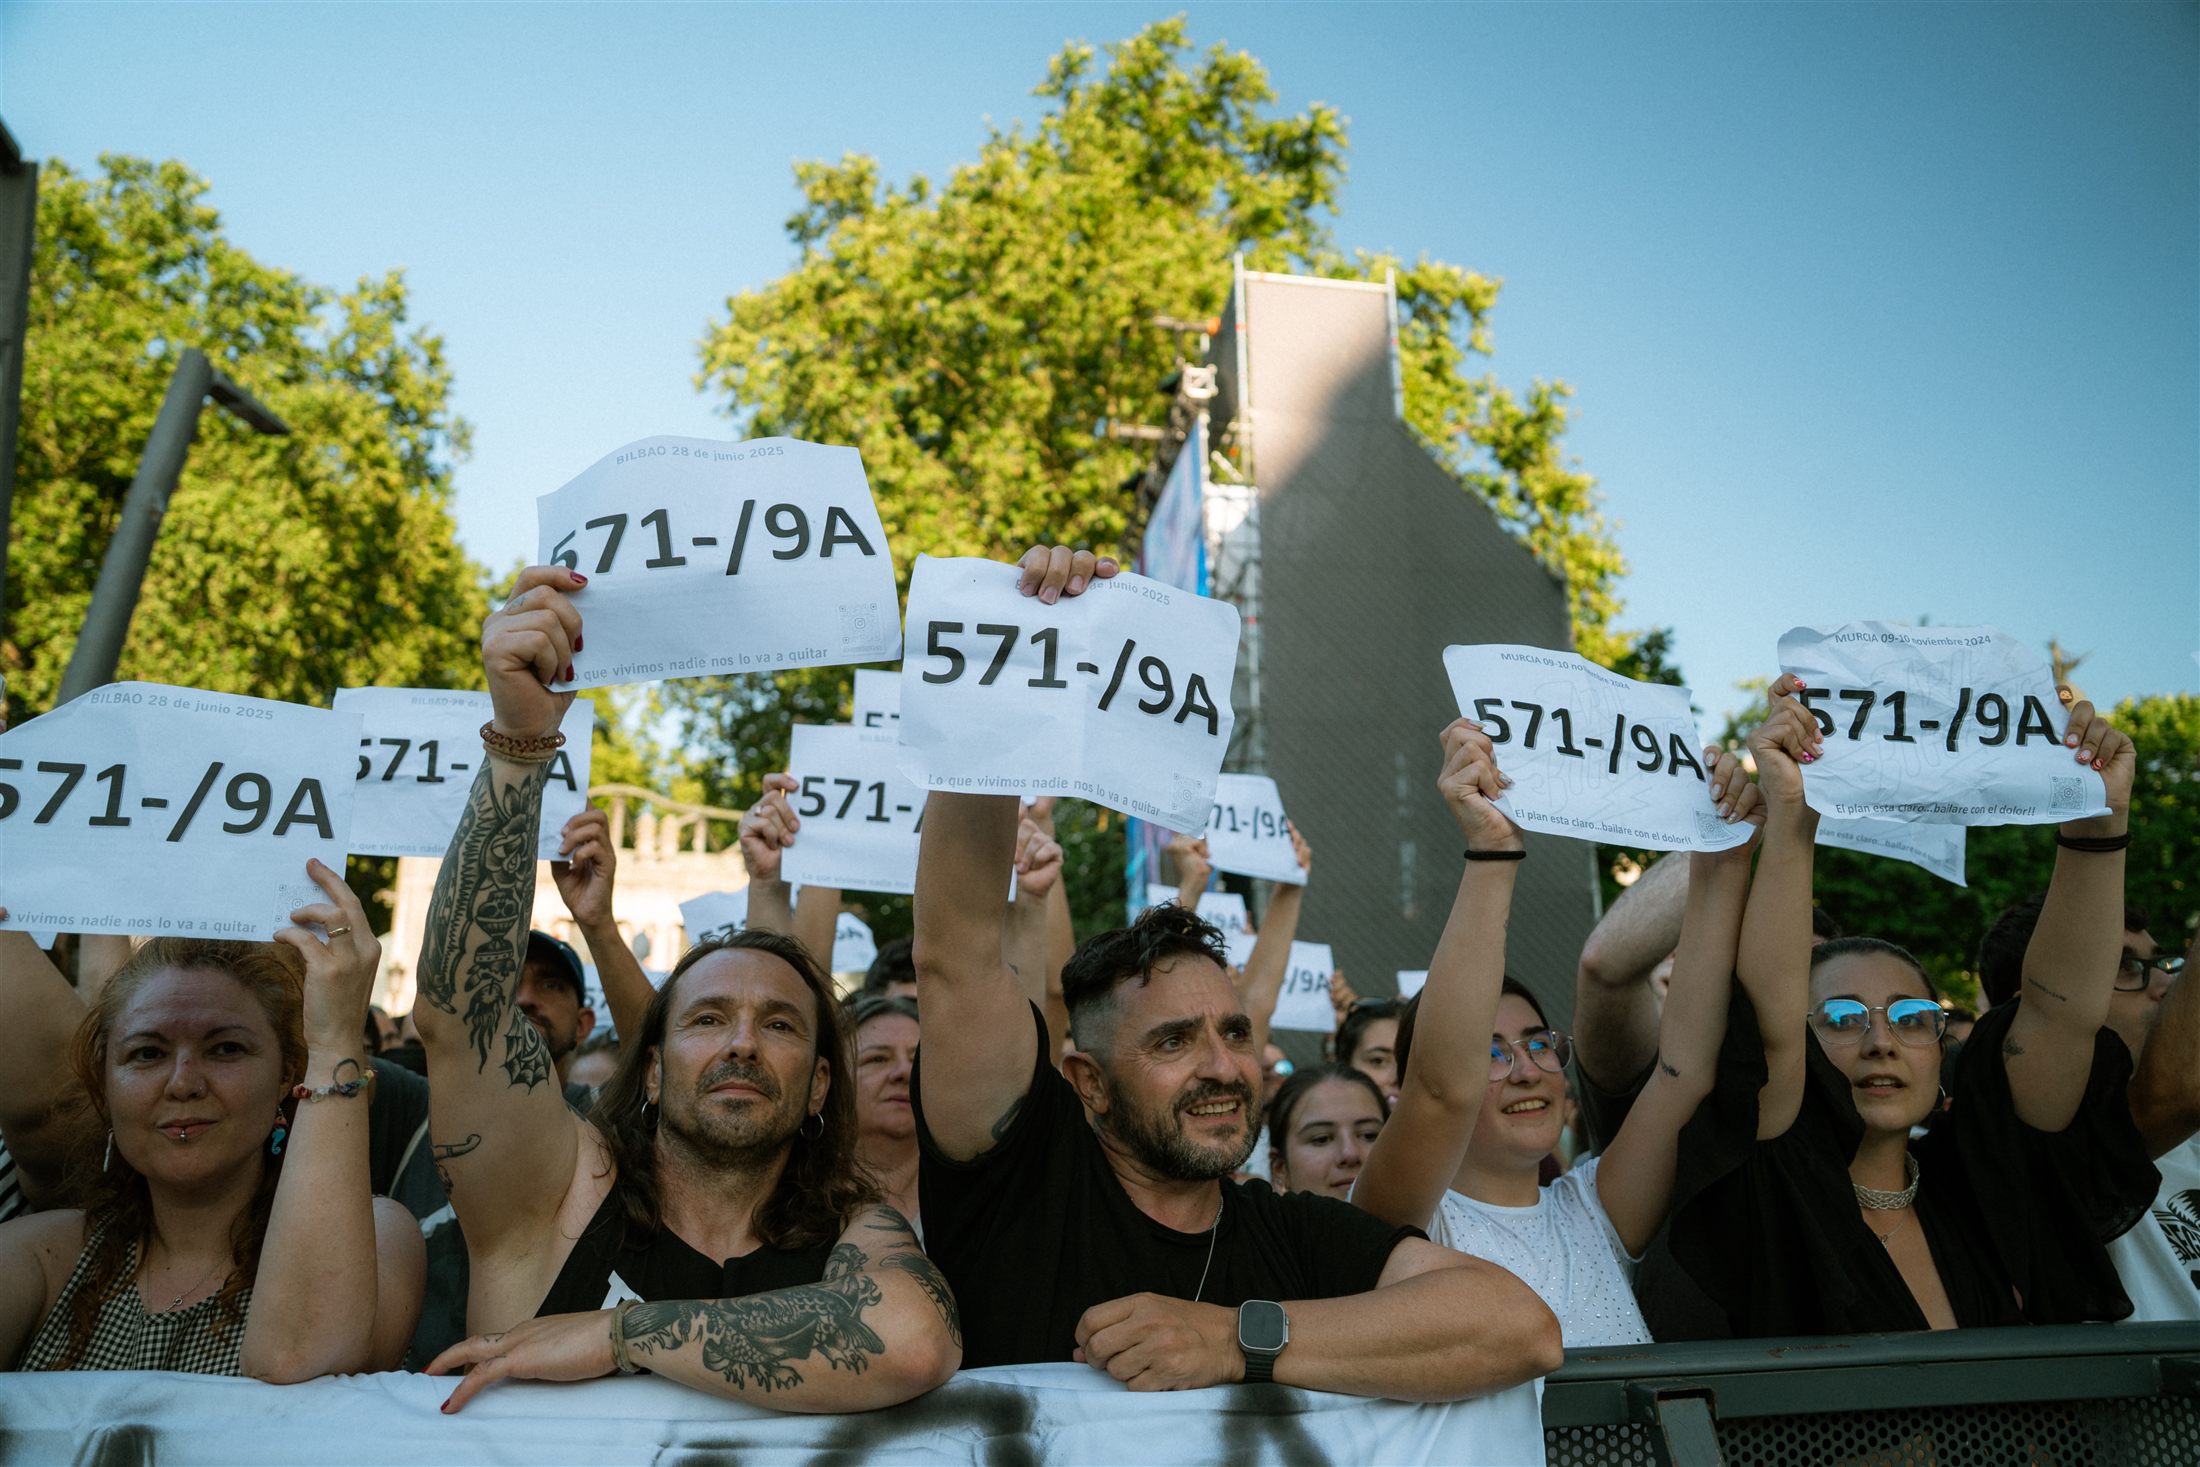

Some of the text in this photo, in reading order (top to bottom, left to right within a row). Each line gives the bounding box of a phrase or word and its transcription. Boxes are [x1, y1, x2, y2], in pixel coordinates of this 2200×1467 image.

[616, 446, 784, 464] BILBAO 28 de junio 2025
[1109, 579, 1138, 593] junio
[1142, 586, 1170, 606] 2025
[1835, 632, 1991, 647] MURCIA 09-10 noviembre 2024
[584, 669, 608, 684] que
[612, 661, 664, 677] vivimos
[669, 655, 706, 672] nadie
[711, 656, 734, 667] nos
[739, 652, 751, 665] lo
[756, 653, 771, 663] va
[776, 653, 784, 662] a
[788, 648, 828, 661] quitar
[1500, 653, 1541, 664] MURCIA
[1543, 659, 1569, 669] 09-10
[922, 620, 1218, 736] 571-/9A
[90, 692, 273, 720] BILBAO 28 de junio 2025
[1800, 687, 2064, 752] 571-/9A
[1473, 698, 1706, 783] 571-/9A
[928, 773, 1160, 816] Lo que vivimos nadie nos lo va a quitar
[1835, 804, 1845, 814] El
[1848, 803, 1870, 816] plan
[1872, 803, 1894, 813] esta
[1970, 807, 1986, 815] con
[1988, 804, 1997, 814] el
[2000, 803, 2036, 817] dolor!!
[1205, 804, 1291, 840] 71-/9A
[1514, 809, 1525, 818] El
[1527, 811, 1548, 823] plan
[1550, 814, 1570, 826] esta
[1634, 828, 1650, 840] con
[1652, 831, 1660, 841] el
[1661, 832, 1692, 846] dolor!!
[17, 912, 75, 926] vivimos
[81, 914, 122, 928] nadie
[128, 918, 152, 929] nos
[158, 917, 171, 929] lo
[177, 919, 193, 930] va
[200, 920, 207, 930] a
[213, 920, 257, 934] quitar
